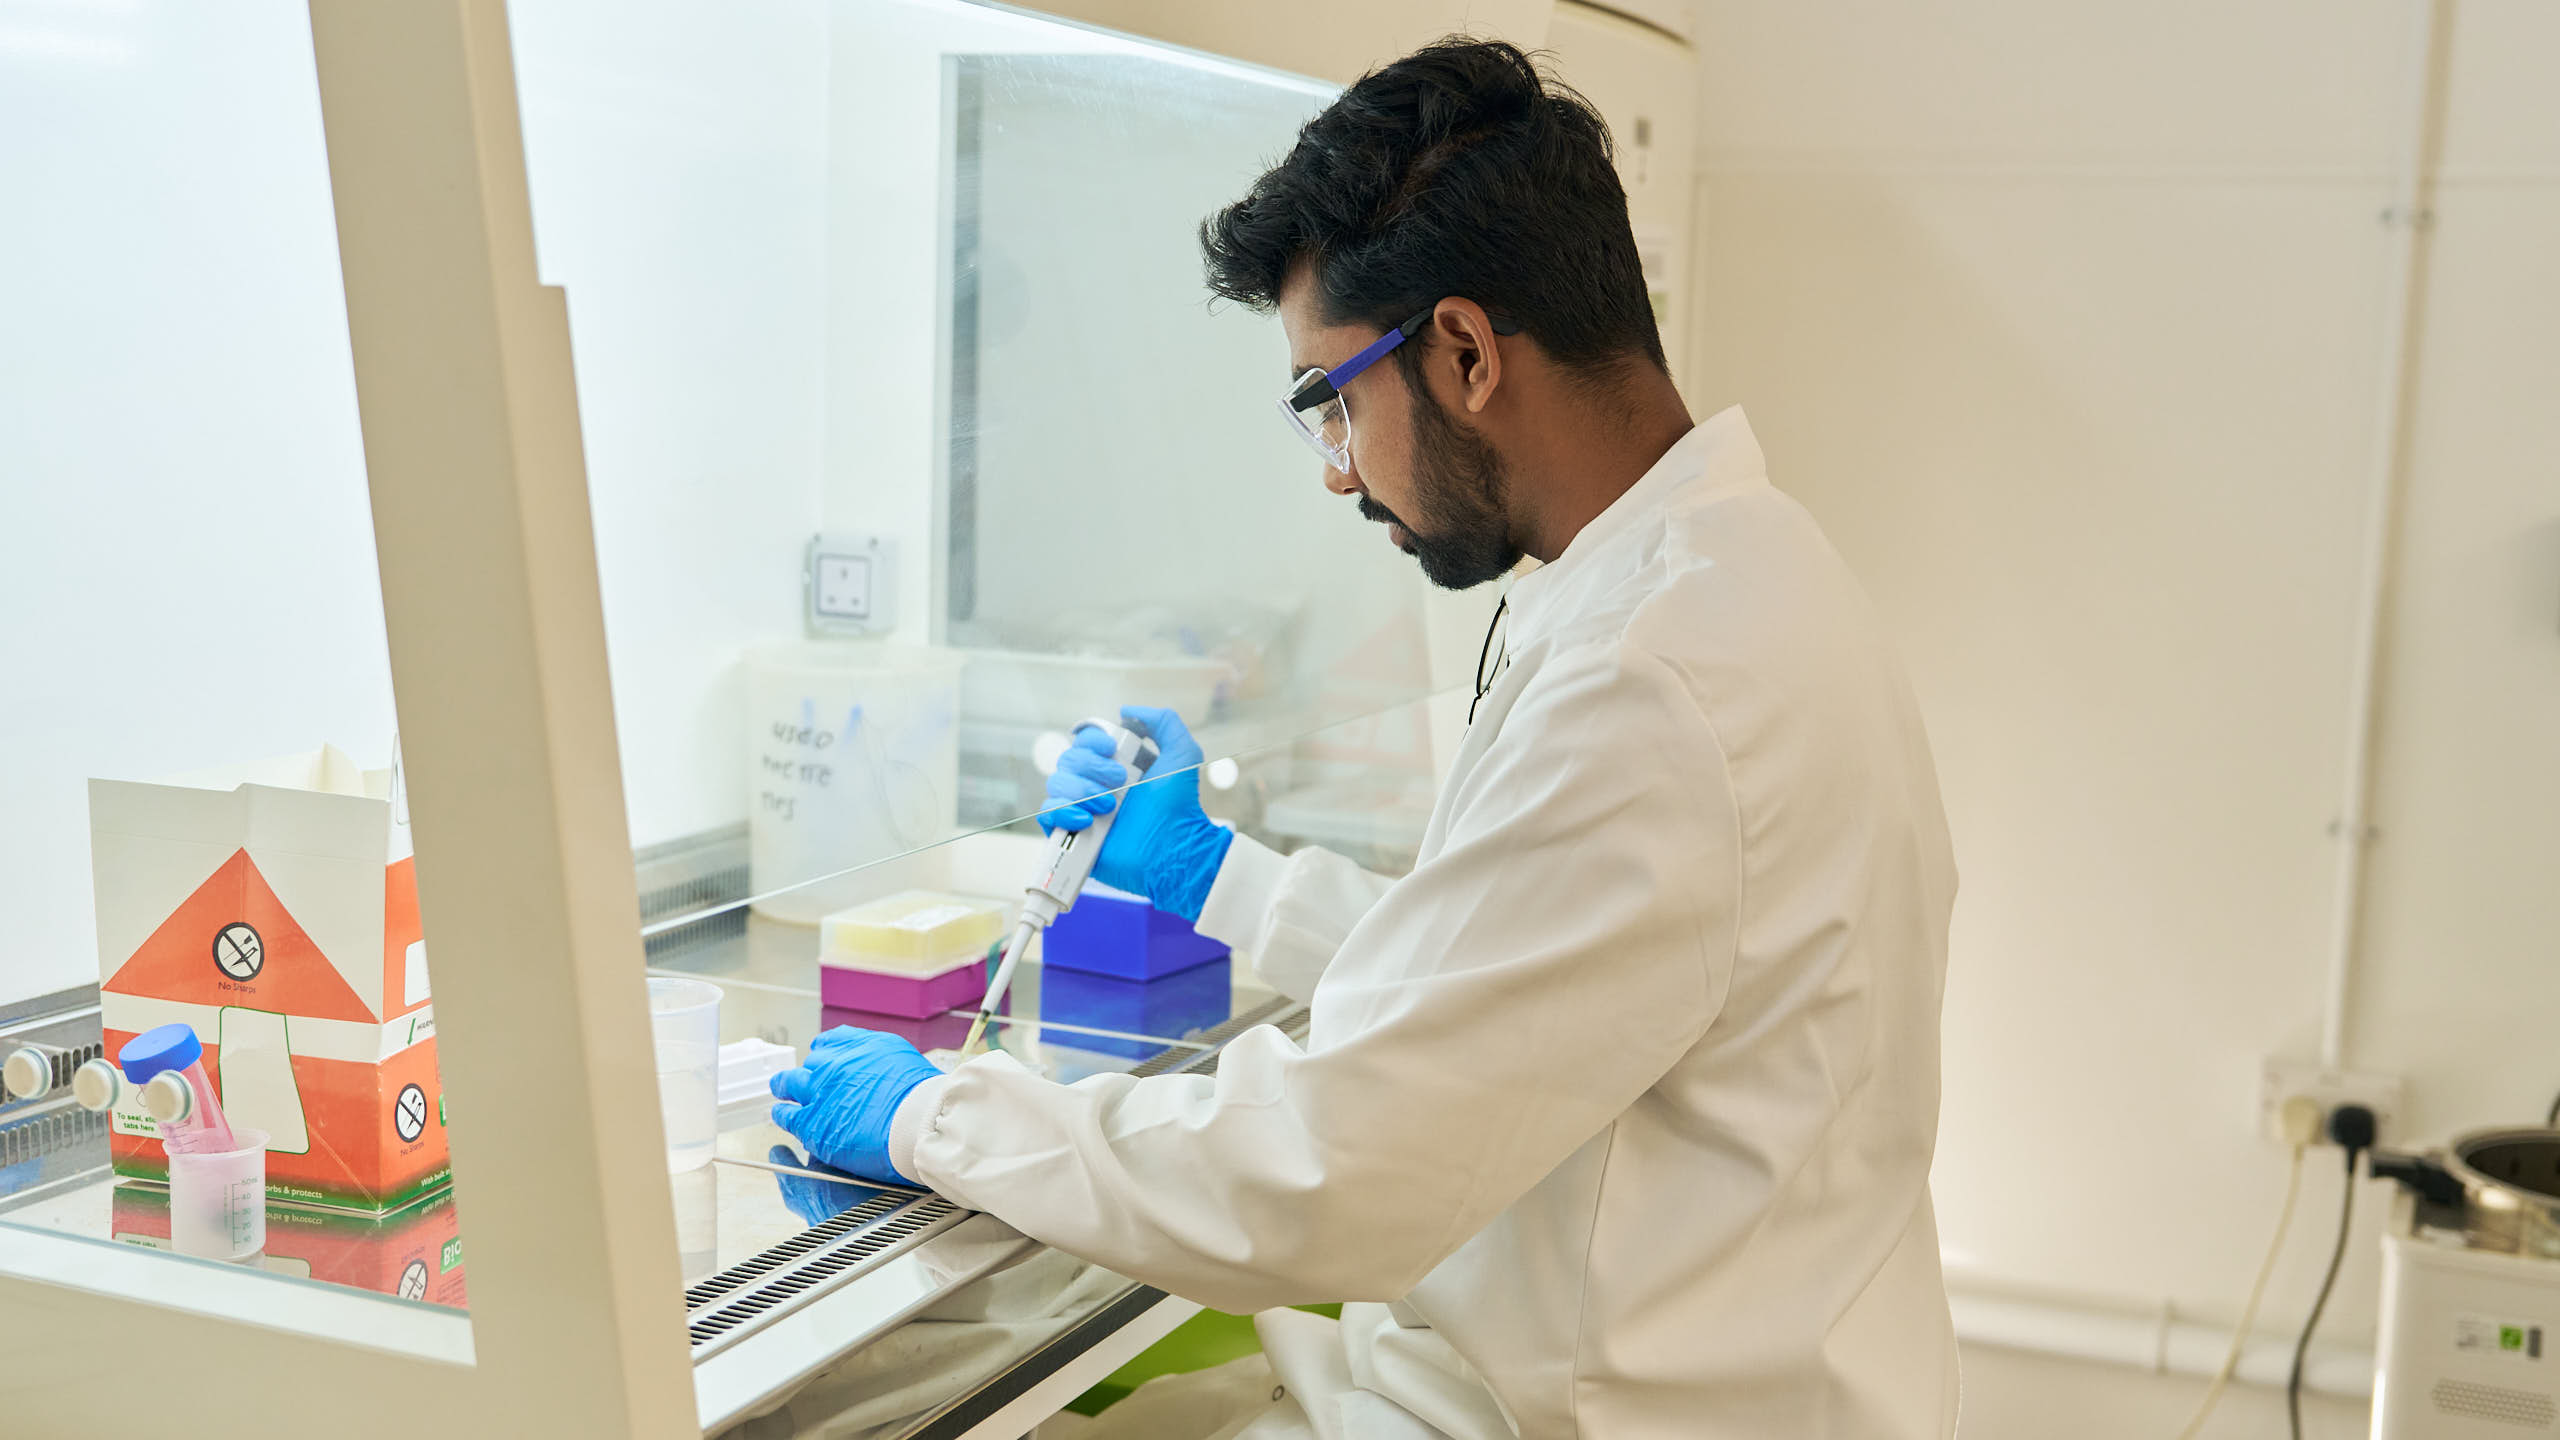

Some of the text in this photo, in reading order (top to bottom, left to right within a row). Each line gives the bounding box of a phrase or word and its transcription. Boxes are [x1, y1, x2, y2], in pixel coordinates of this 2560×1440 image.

[217, 981, 231, 991] No
[117, 1111, 126, 1120] To
[265, 1184, 323, 1199] orbs & protects
